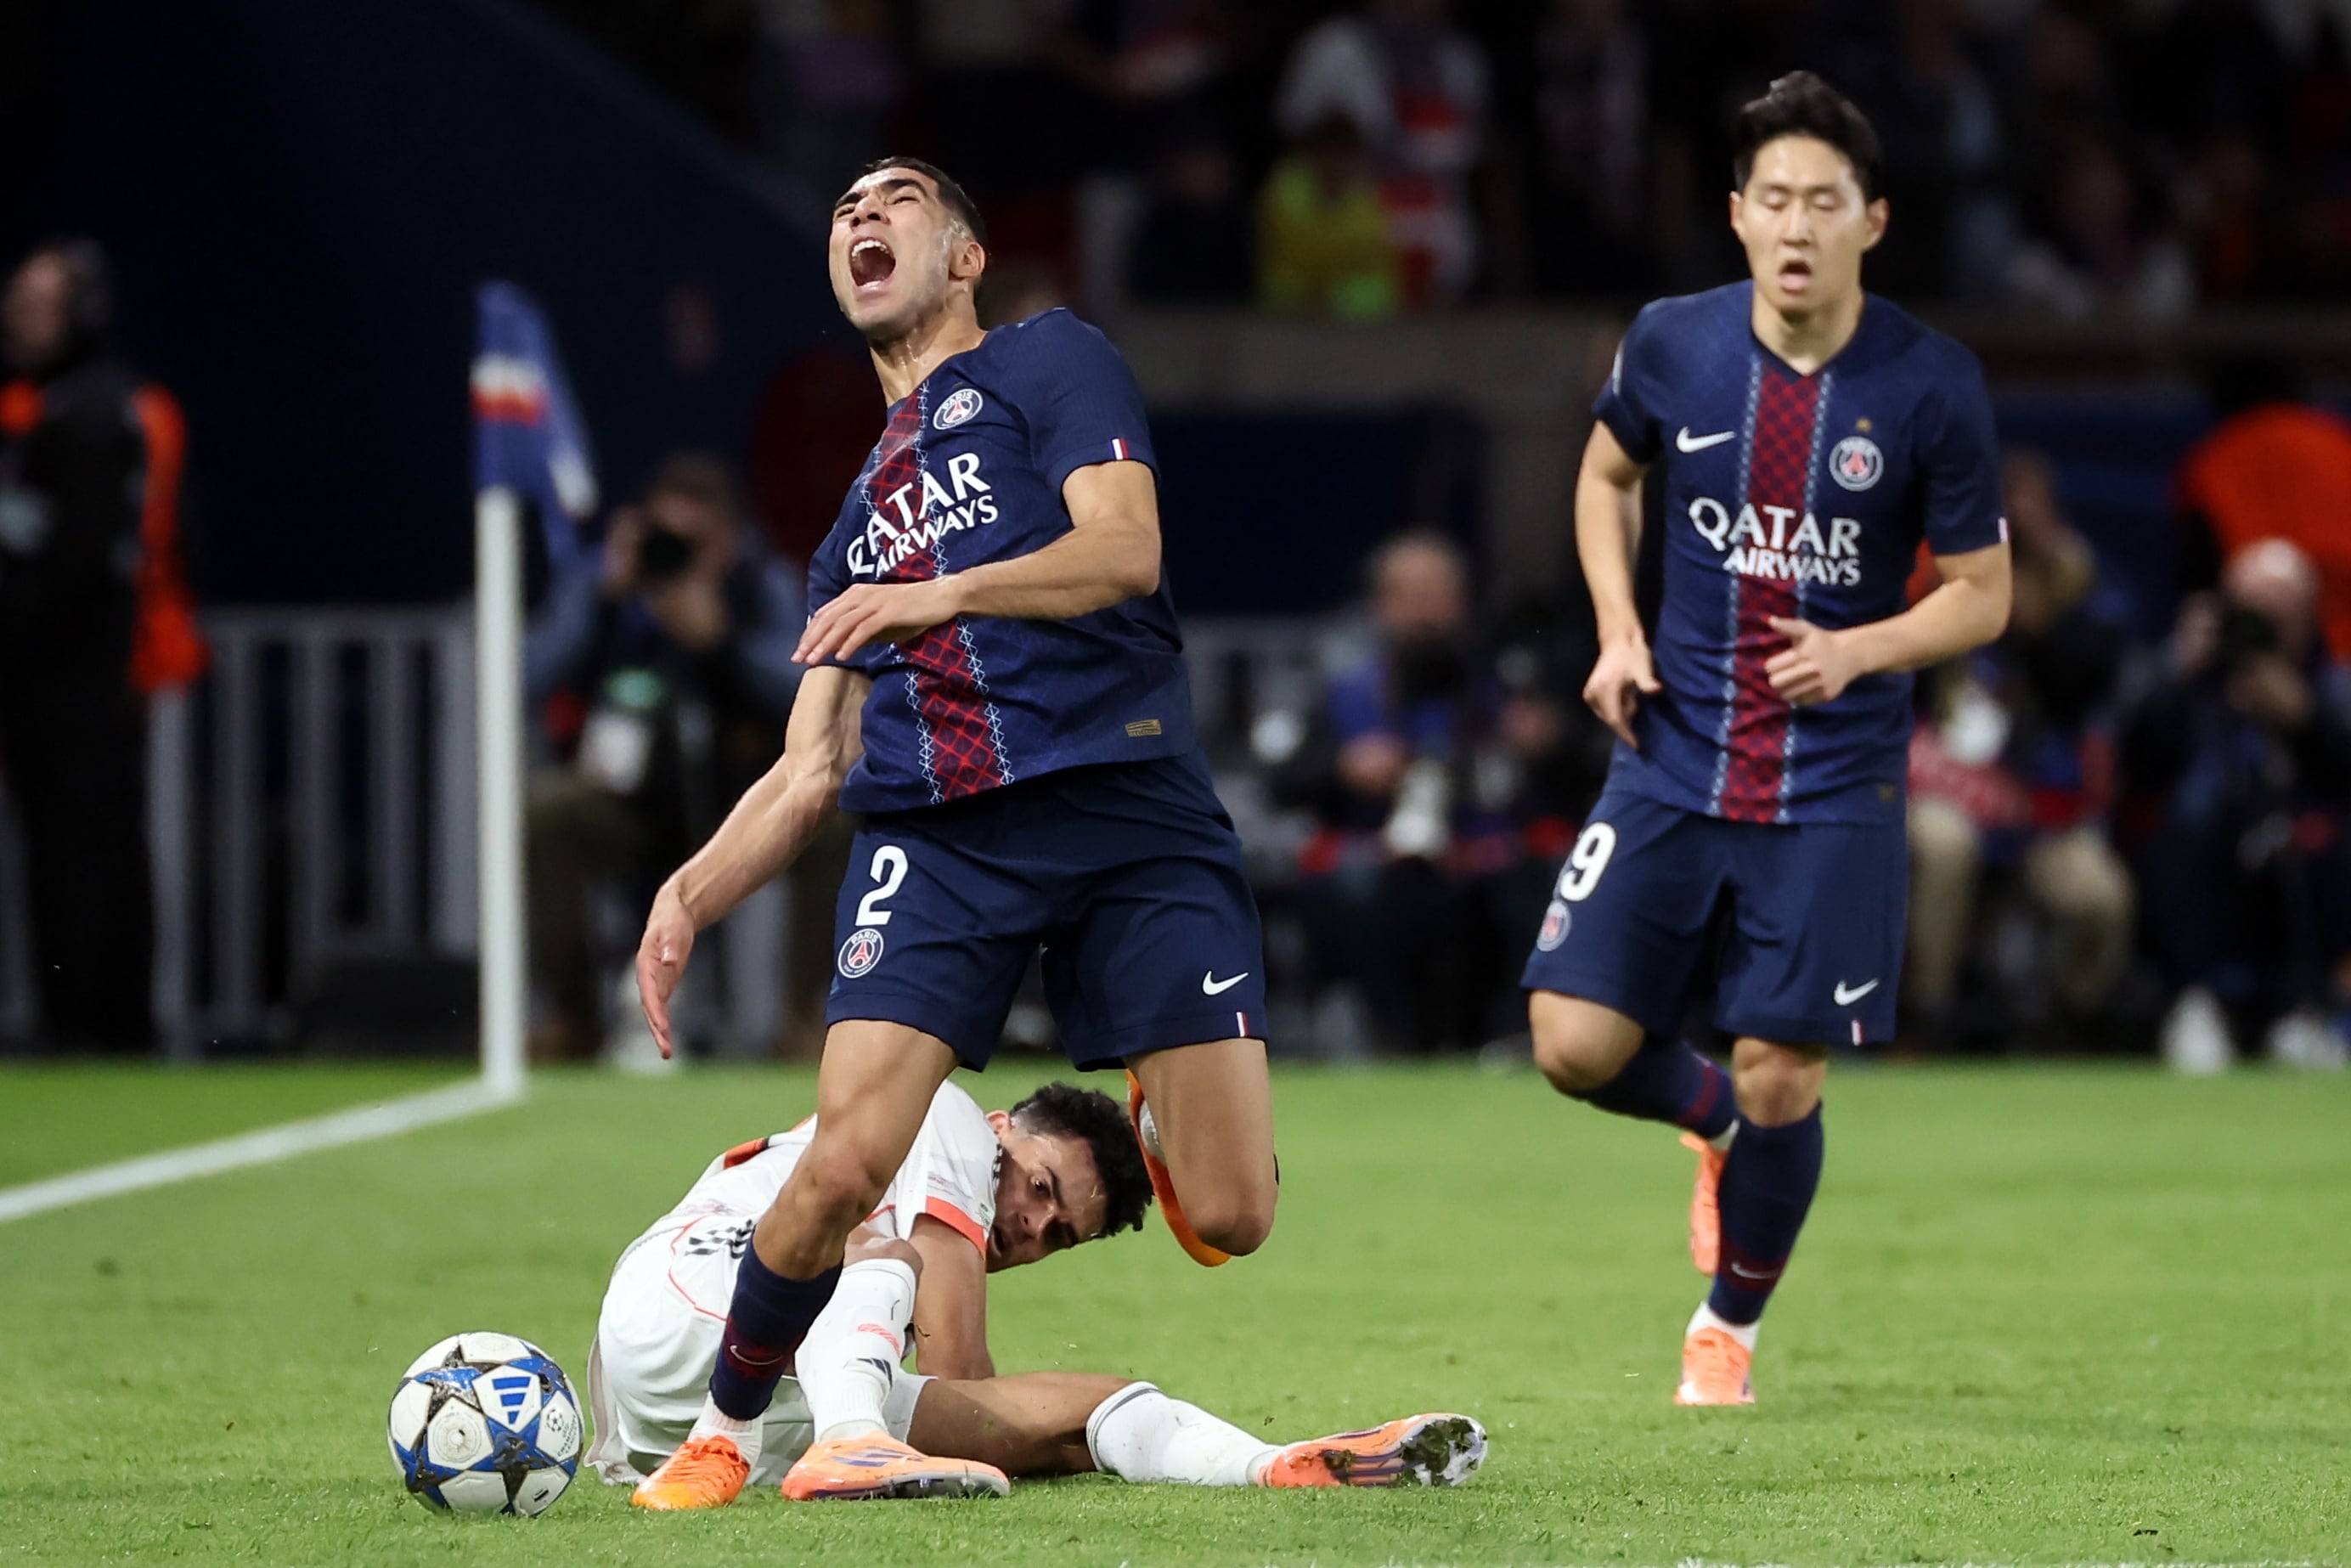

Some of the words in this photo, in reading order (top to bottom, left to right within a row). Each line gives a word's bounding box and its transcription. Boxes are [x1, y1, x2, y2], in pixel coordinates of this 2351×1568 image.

[846, 453, 991, 577] QATAR
[876, 495, 999, 578] AIRWAYS
[1688, 496, 1862, 559] QATAR
[1722, 545, 1862, 586] AIRWAYS
[854, 845, 908, 926] 2
[850, 931, 879, 945] PARIS
